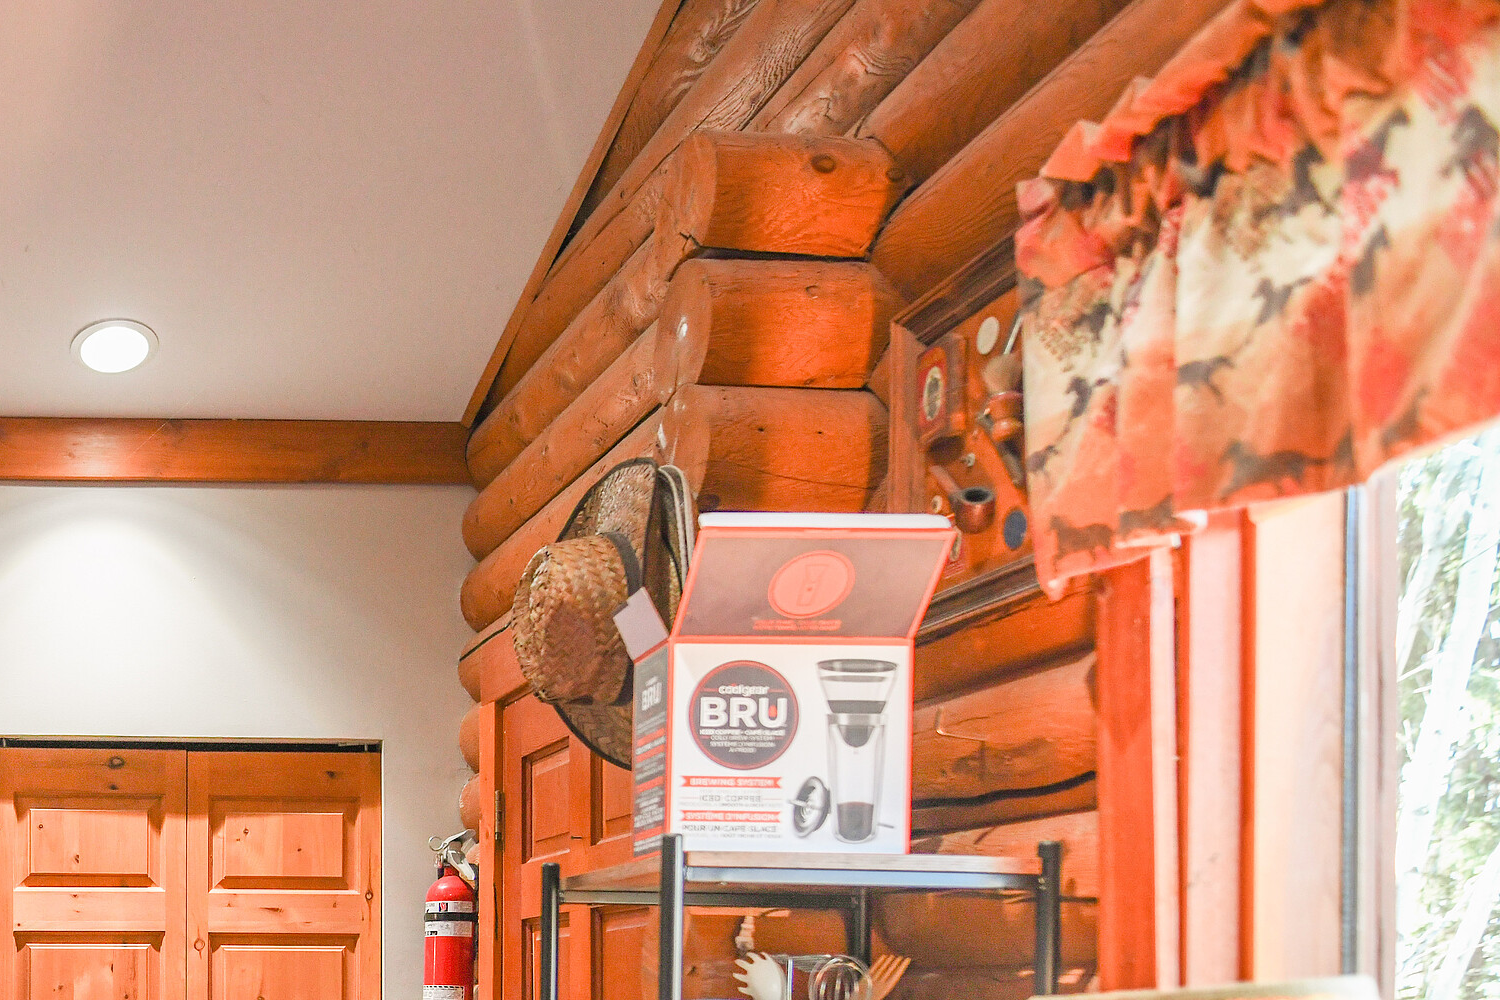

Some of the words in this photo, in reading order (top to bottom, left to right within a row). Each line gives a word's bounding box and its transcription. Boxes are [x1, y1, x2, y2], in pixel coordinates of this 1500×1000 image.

[642, 682, 662, 711] BRU
[700, 697, 788, 728] BRU
[690, 778, 735, 786] BREWING
